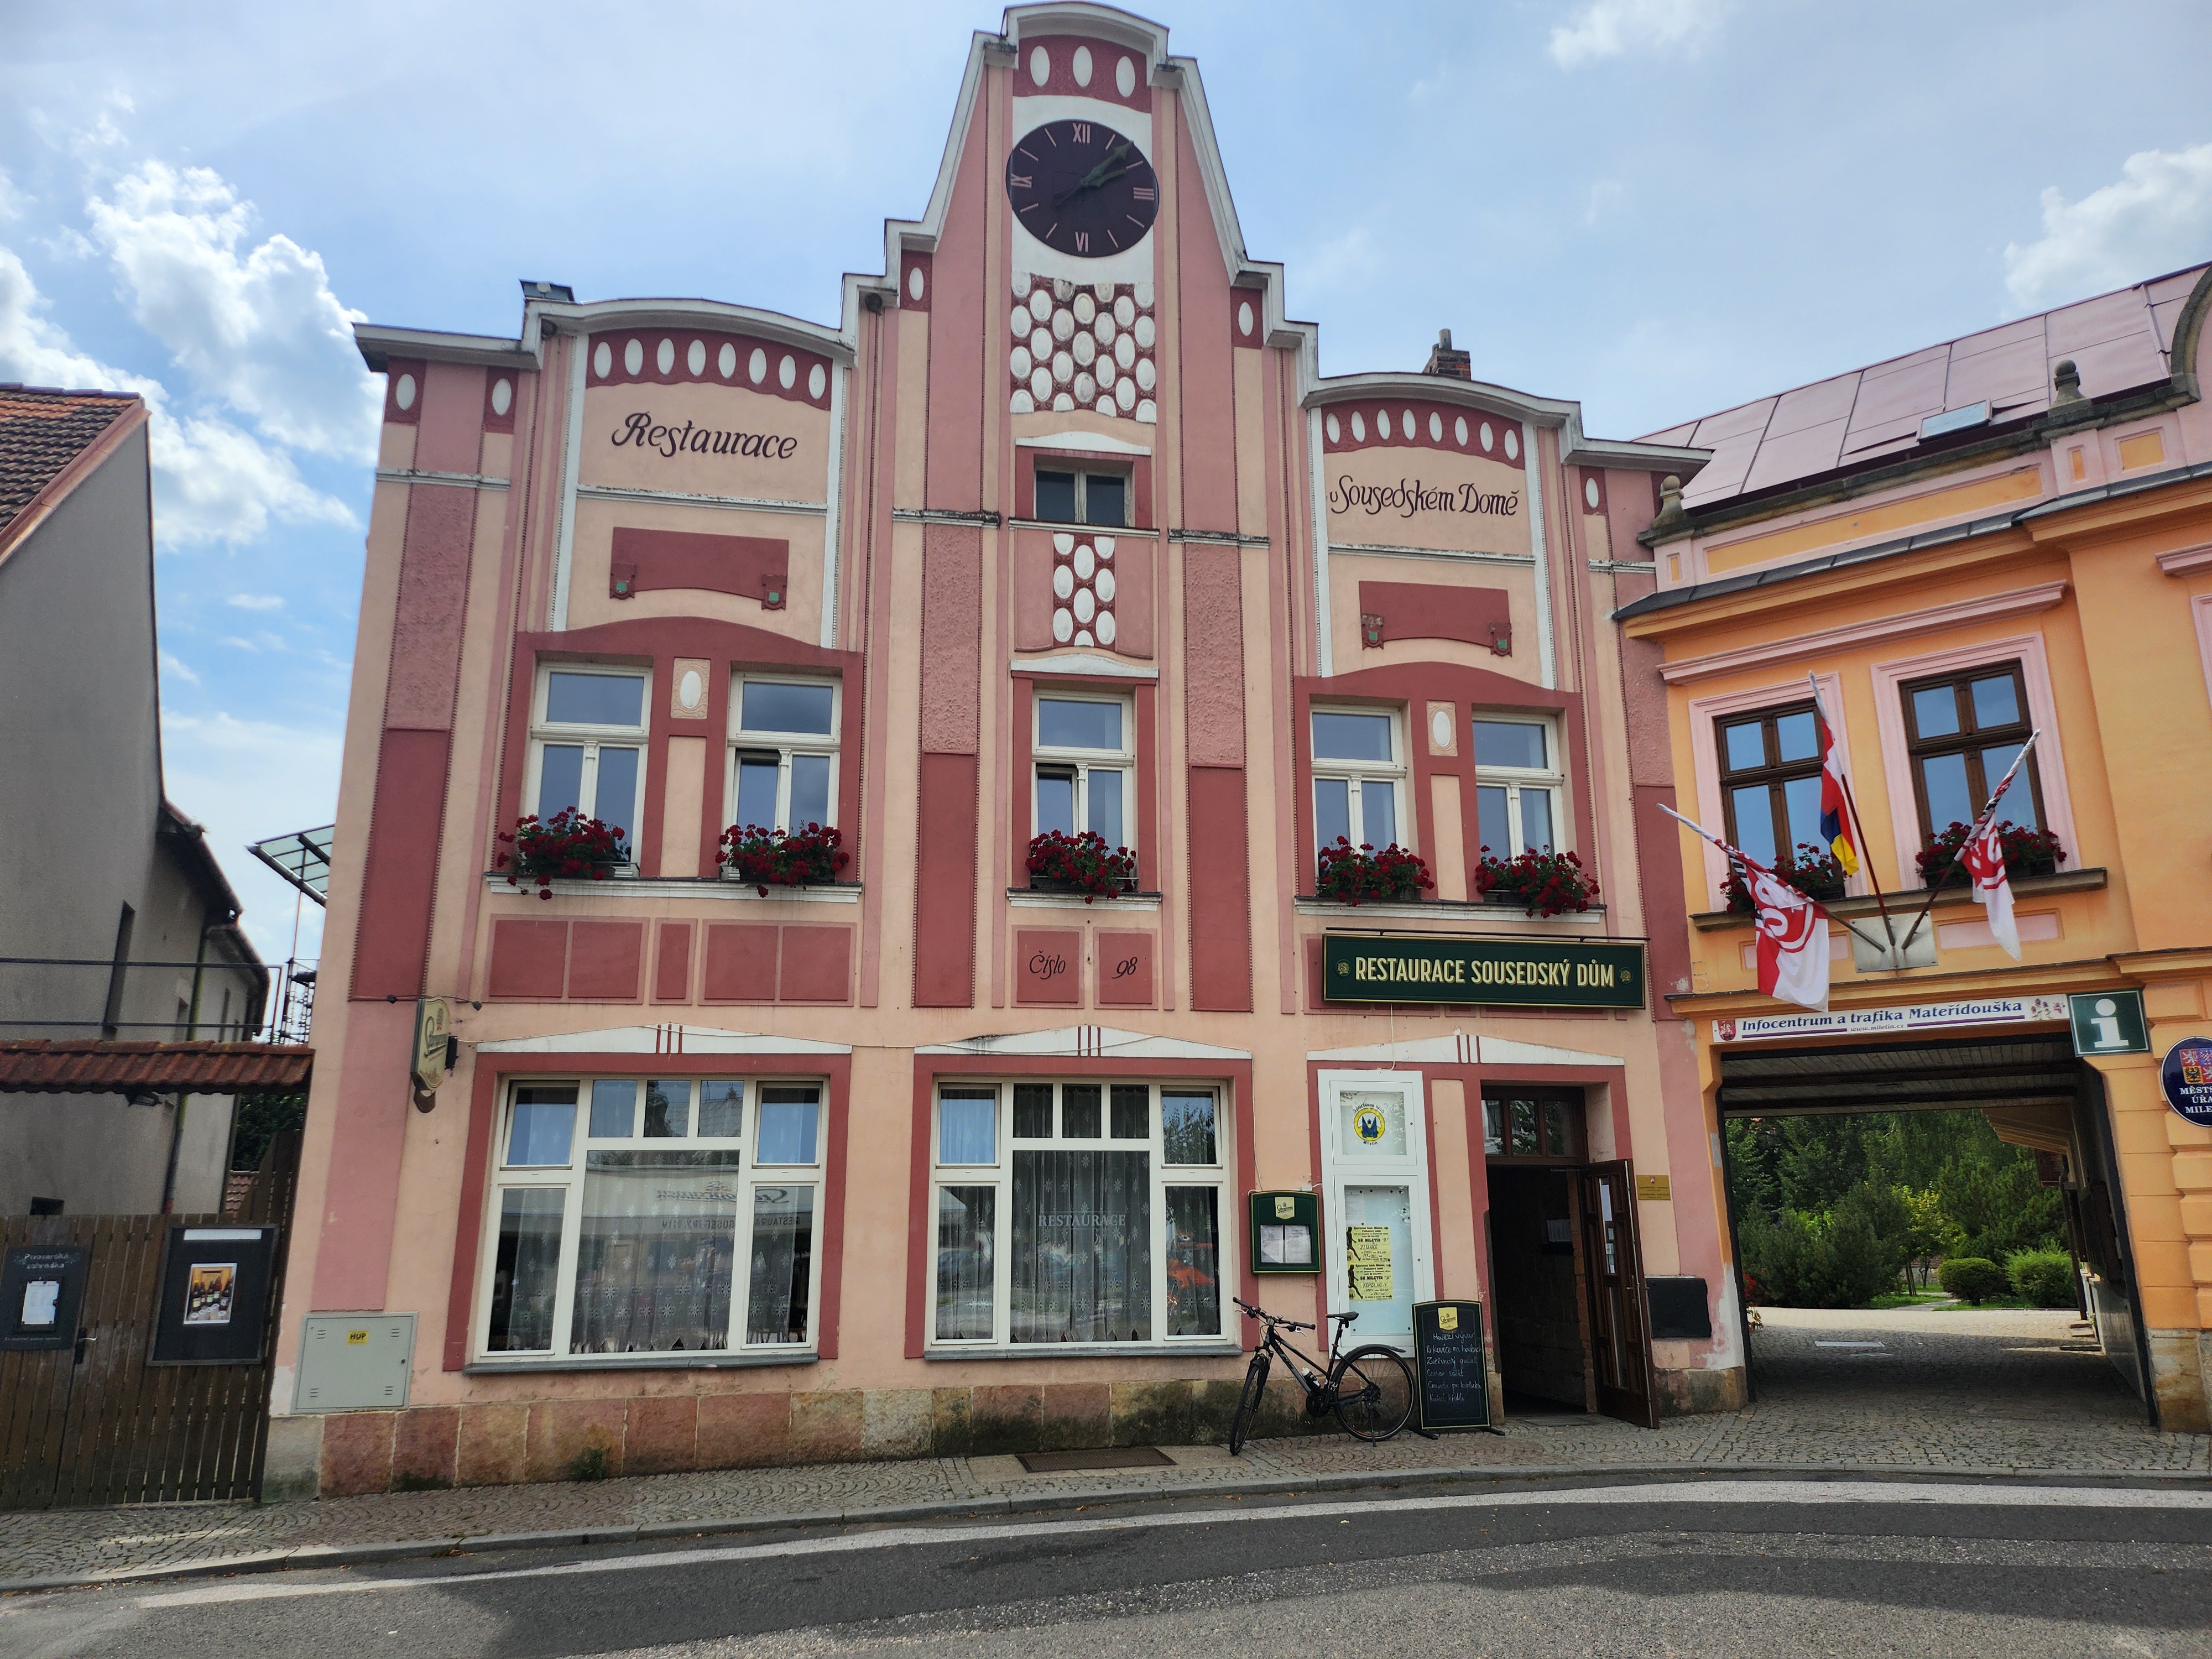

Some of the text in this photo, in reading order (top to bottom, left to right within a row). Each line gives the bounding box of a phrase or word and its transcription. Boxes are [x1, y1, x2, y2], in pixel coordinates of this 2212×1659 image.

[1072, 122, 1091, 144] XII
[1133, 187, 1155, 201] III
[1074, 231, 1089, 253] VI
[611, 411, 797, 459] Restaurace
[1331, 475, 1456, 518] Sousedském
[1458, 483, 1520, 516] Domě
[1029, 950, 1138, 980] Číslo 98
[1355, 957, 1615, 988] RESTAURACE SOUSEDSKÝ DŮM
[1741, 1000, 2023, 1032] Infocentrum a trafika Mateřídouška
[1037, 1214, 1126, 1227] RESTAURACE
